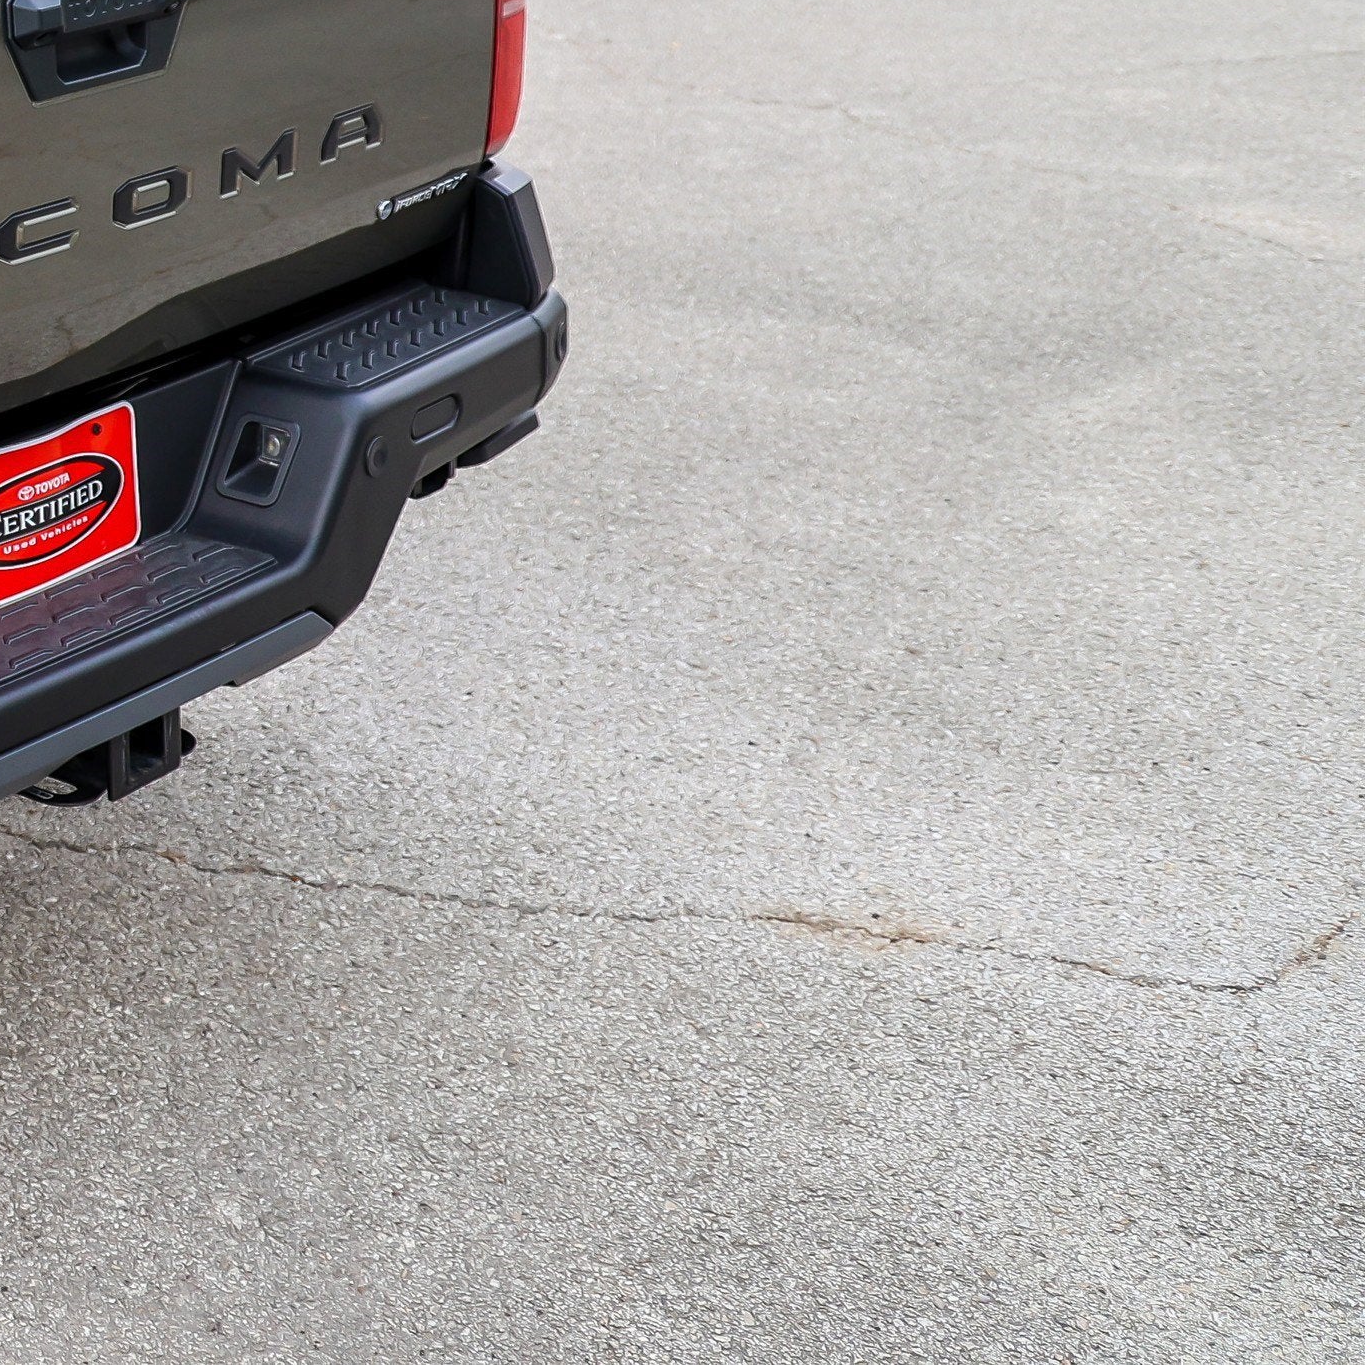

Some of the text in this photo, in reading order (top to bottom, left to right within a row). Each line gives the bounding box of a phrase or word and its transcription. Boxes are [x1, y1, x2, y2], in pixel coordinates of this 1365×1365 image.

[34, 472, 71, 496] TOYOTA
[2, 515, 89, 555] Used Vehicles
